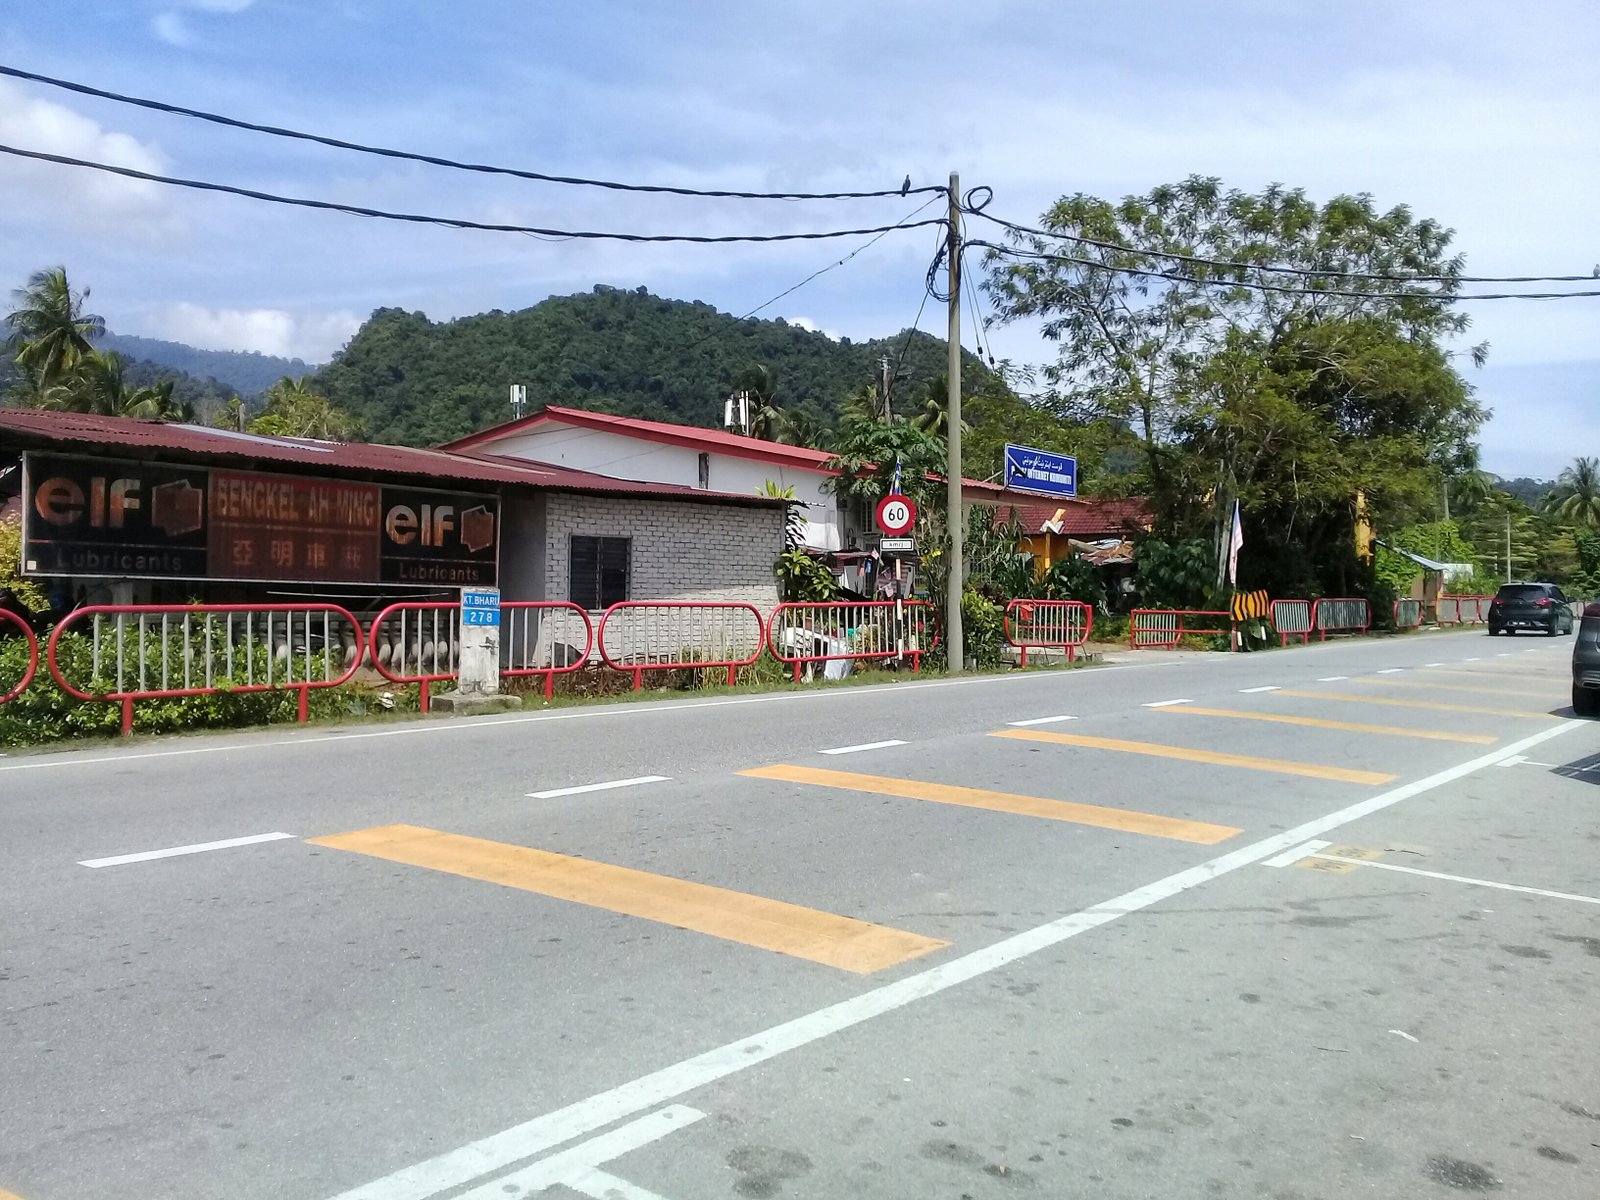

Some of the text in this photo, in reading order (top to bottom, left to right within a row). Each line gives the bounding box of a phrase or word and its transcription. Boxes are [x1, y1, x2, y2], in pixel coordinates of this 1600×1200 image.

[34, 477, 141, 528] elf
[217, 478, 374, 527] BENGKEL AH MING
[385, 504, 455, 547] elf
[888, 507, 904, 522] 60
[56, 550, 183, 572] Lubricants
[399, 562, 481, 581] Lubricants
[470, 611, 493, 623] 278
